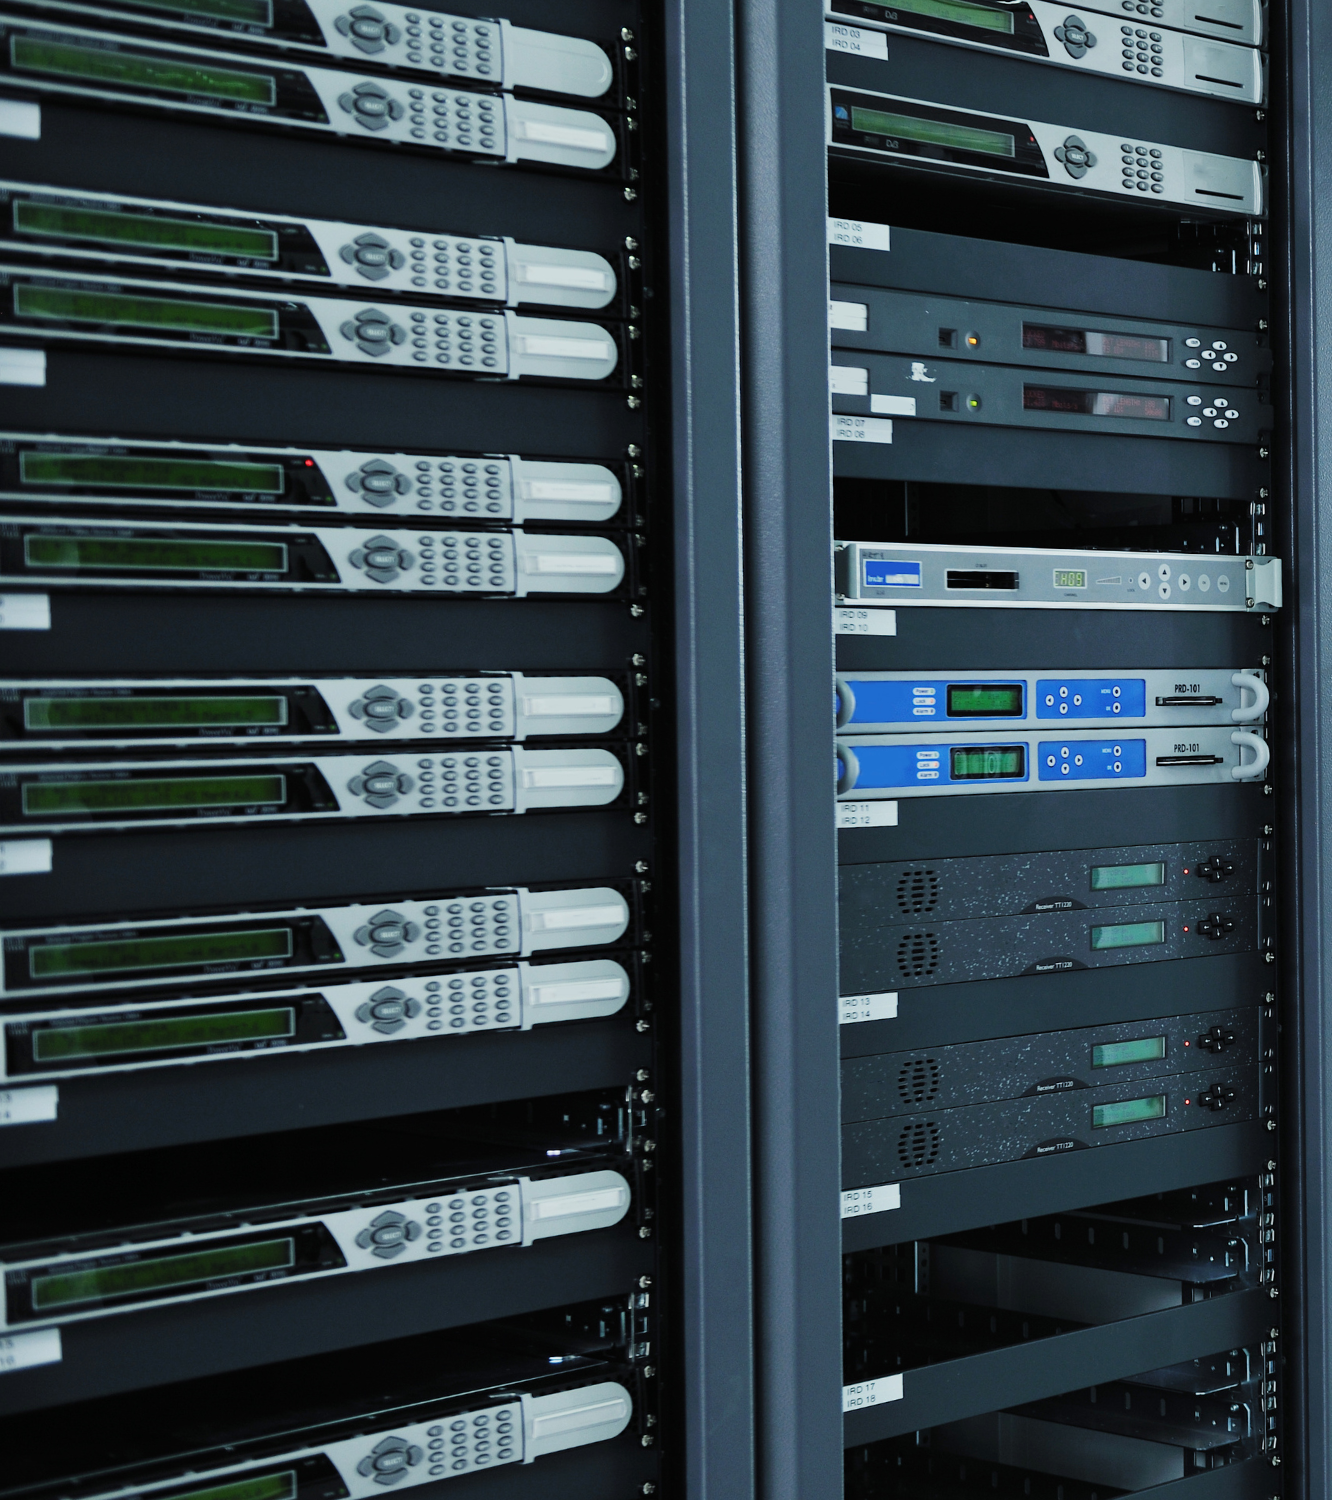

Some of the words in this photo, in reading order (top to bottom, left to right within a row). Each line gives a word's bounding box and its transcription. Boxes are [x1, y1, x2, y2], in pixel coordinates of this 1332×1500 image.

[832, 26, 848, 37] IRD
[850, 29, 860, 39] 03
[832, 39, 848, 49] IRD
[850, 41, 861, 51] 04
[834, 221, 849, 231] IRD
[852, 222, 863, 232] 05
[834, 233, 849, 243] IRD
[852, 234, 863, 244] 06
[837, 418, 853, 426] IRD
[855, 419, 865, 427] 07
[837, 430, 853, 438] IRD
[839, 610, 855, 619] IRD
[857, 611, 868, 619] 09
[839, 623, 855, 631] IRD
[859, 624, 868, 632] 10
[1174, 684, 1200, 693] PRD-101
[1174, 743, 1200, 753] PRD-101
[841, 805, 857, 813] IRD
[860, 804, 869, 812] 11
[841, 817, 857, 825] IRD
[860, 816, 870, 824] 12
[1035, 903, 1054, 911] Receiver
[1036, 964, 1055, 972] Receiver
[1055, 961, 1072, 969] TT1220
[843, 999, 858, 1007] IRD
[860, 998, 871, 1006] 13
[843, 1011, 858, 1020] IRD
[861, 1010, 871, 1018] 14
[1056, 1080, 1073, 1088] TT1220
[1037, 1145, 1056, 1153] Receiver
[1056, 1141, 1073, 1149] TT1220
[844, 1192, 860, 1201] IRD
[862, 1190, 872, 1199] 15
[844, 1204, 860, 1214] IRD
[863, 1203, 873, 1211] 16
[847, 1386, 863, 1395] IRD
[866, 1383, 875, 1392] 17
[847, 1398, 863, 1408] IRD
[866, 1395, 876, 1404] 18
